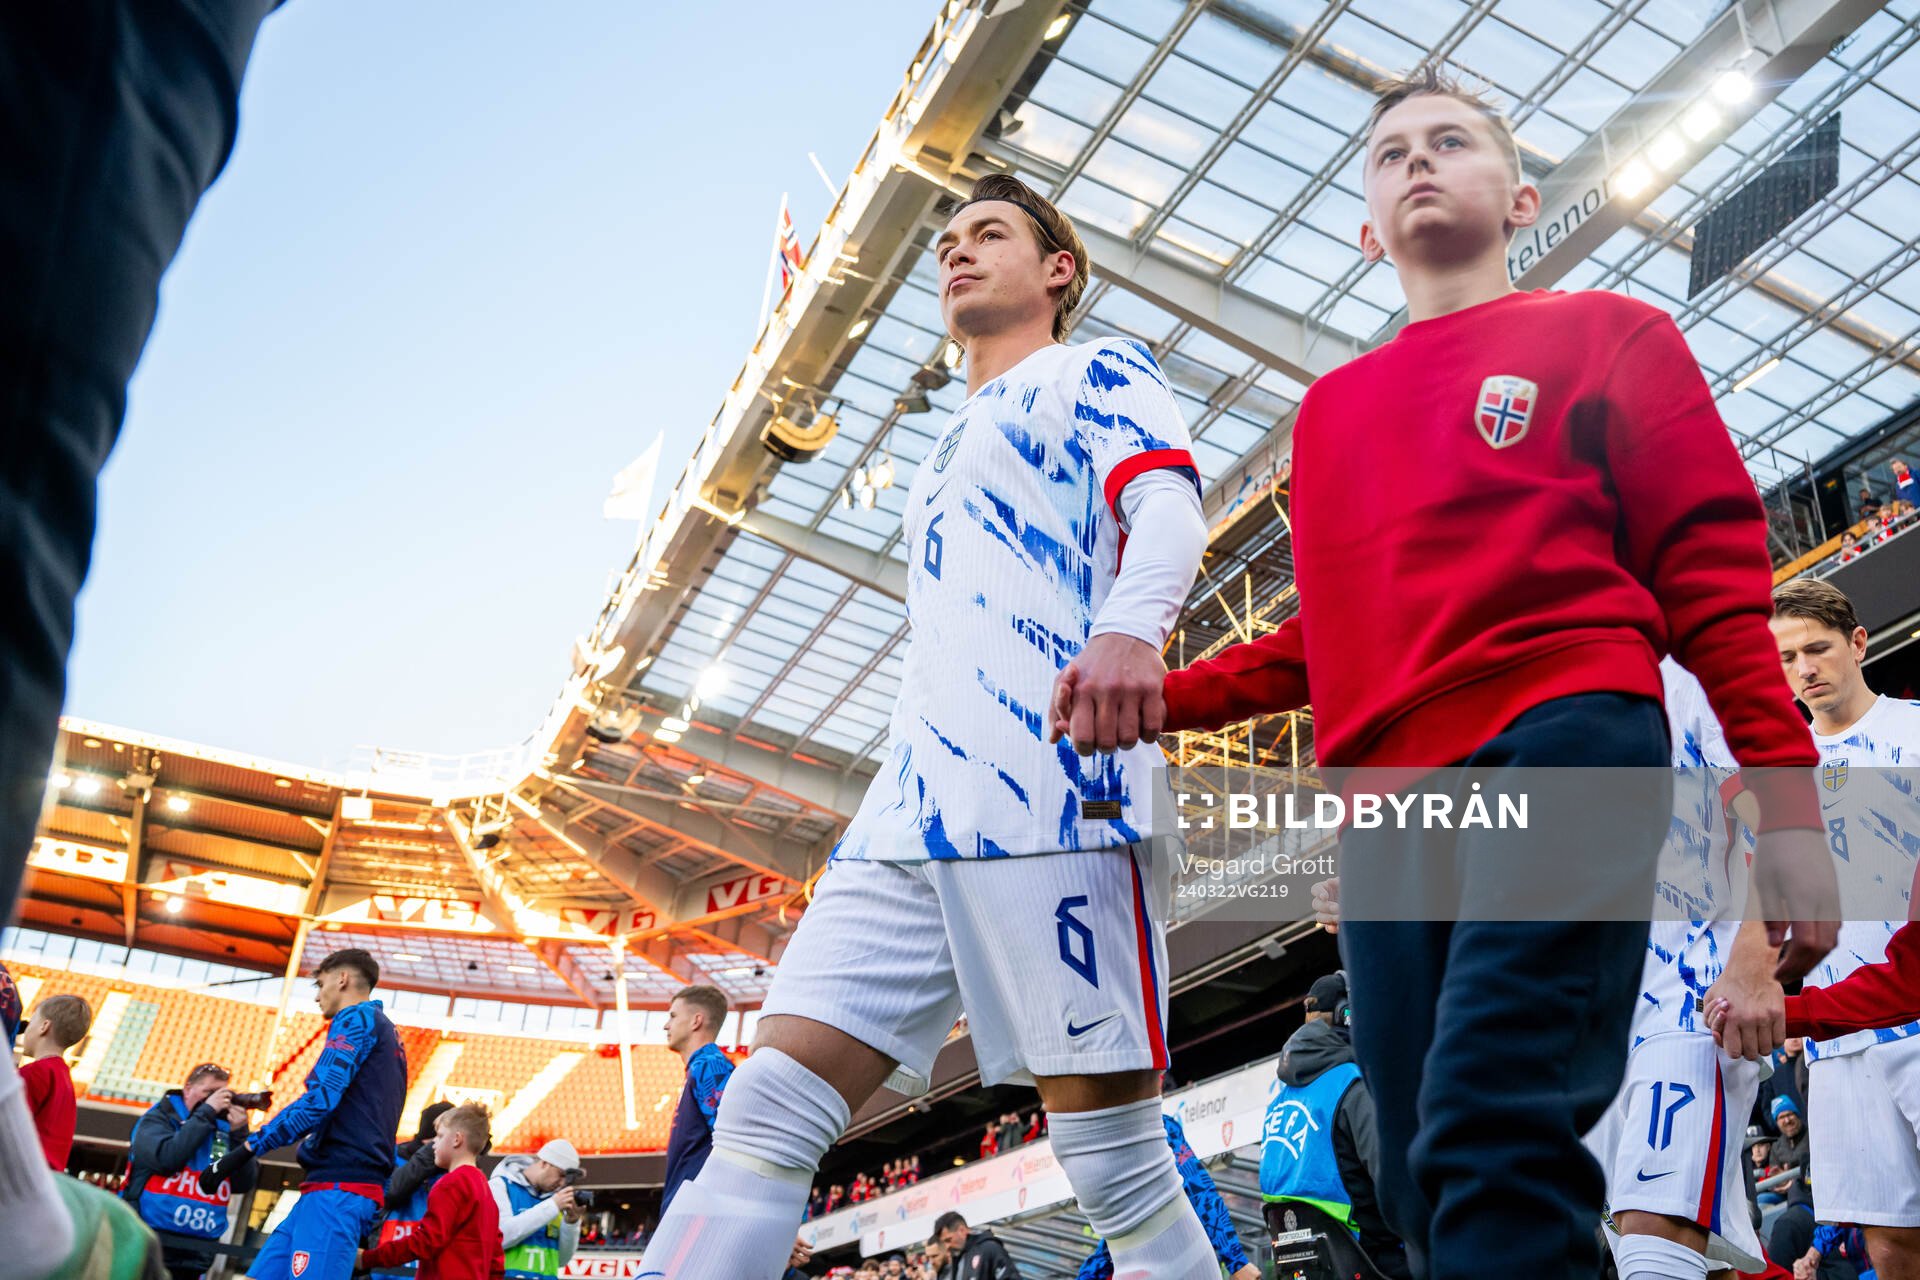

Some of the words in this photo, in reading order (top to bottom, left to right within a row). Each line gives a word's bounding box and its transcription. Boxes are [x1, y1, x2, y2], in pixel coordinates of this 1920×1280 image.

[1508, 178, 1609, 282] telenor
[924, 511, 944, 581] 6
[1828, 817, 1850, 863] 8
[710, 875, 785, 911] VG
[1055, 895, 1099, 989] 6
[1185, 1096, 1227, 1123] telenor
[1648, 1081, 1696, 1151] 17
[162, 1170, 231, 1201] PHOO
[568, 1259, 617, 1277] VG
